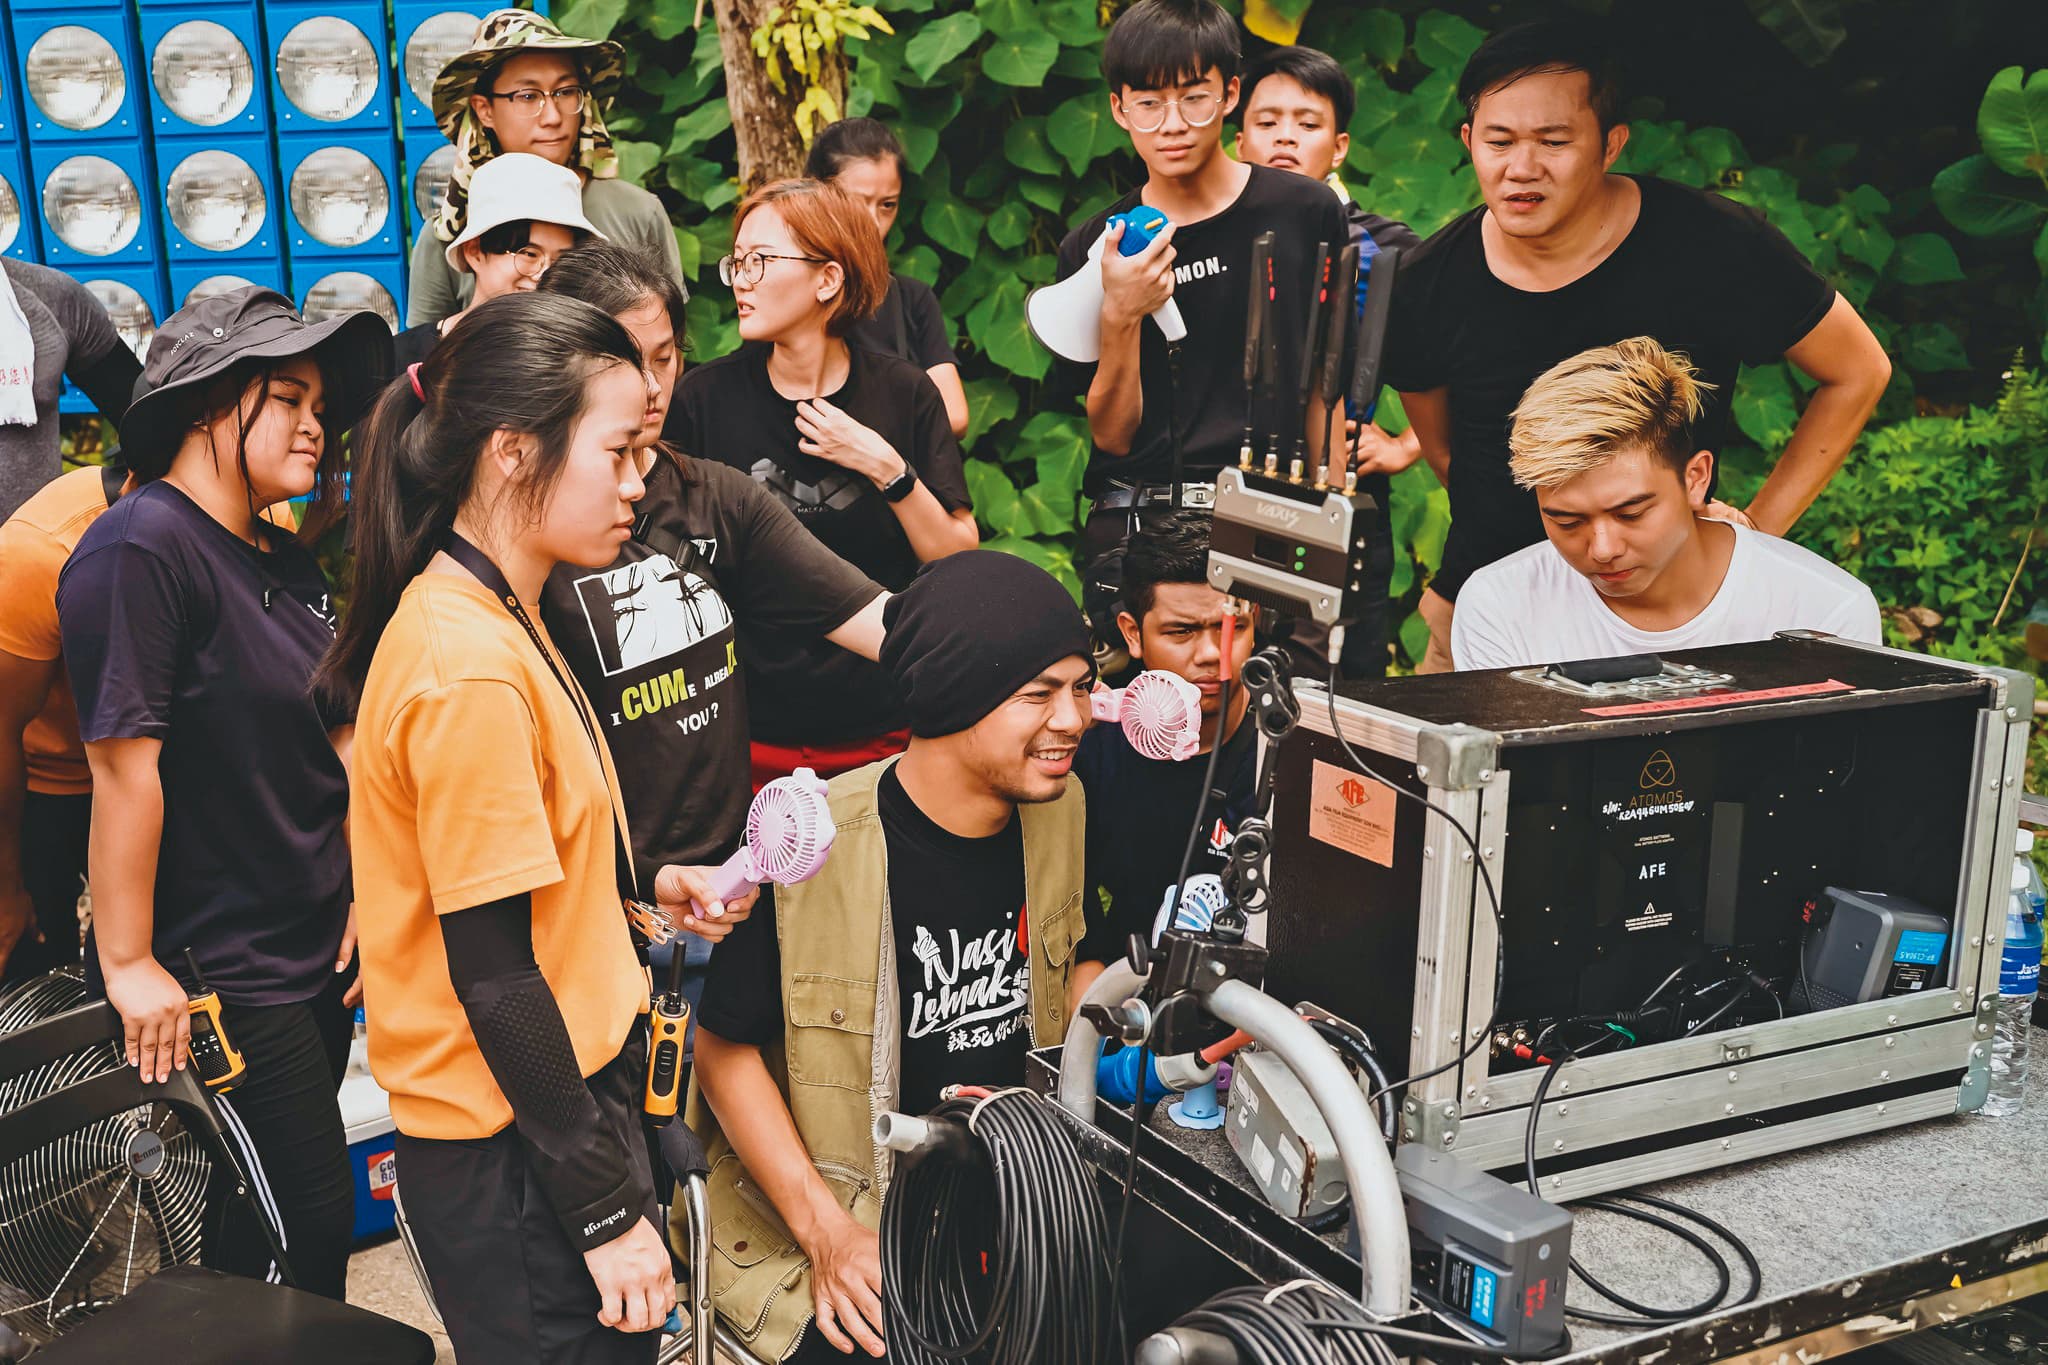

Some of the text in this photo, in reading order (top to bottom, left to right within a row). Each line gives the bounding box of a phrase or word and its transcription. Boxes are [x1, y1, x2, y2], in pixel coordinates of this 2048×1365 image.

[1629, 790, 1684, 809] ATOMOS
[1638, 862, 1666, 880] AFE
[912, 911, 1017, 991] Nasi
[907, 959, 1014, 1039] Lemak
[380, 1160, 394, 1173] CO
[381, 1170, 395, 1184] BO
